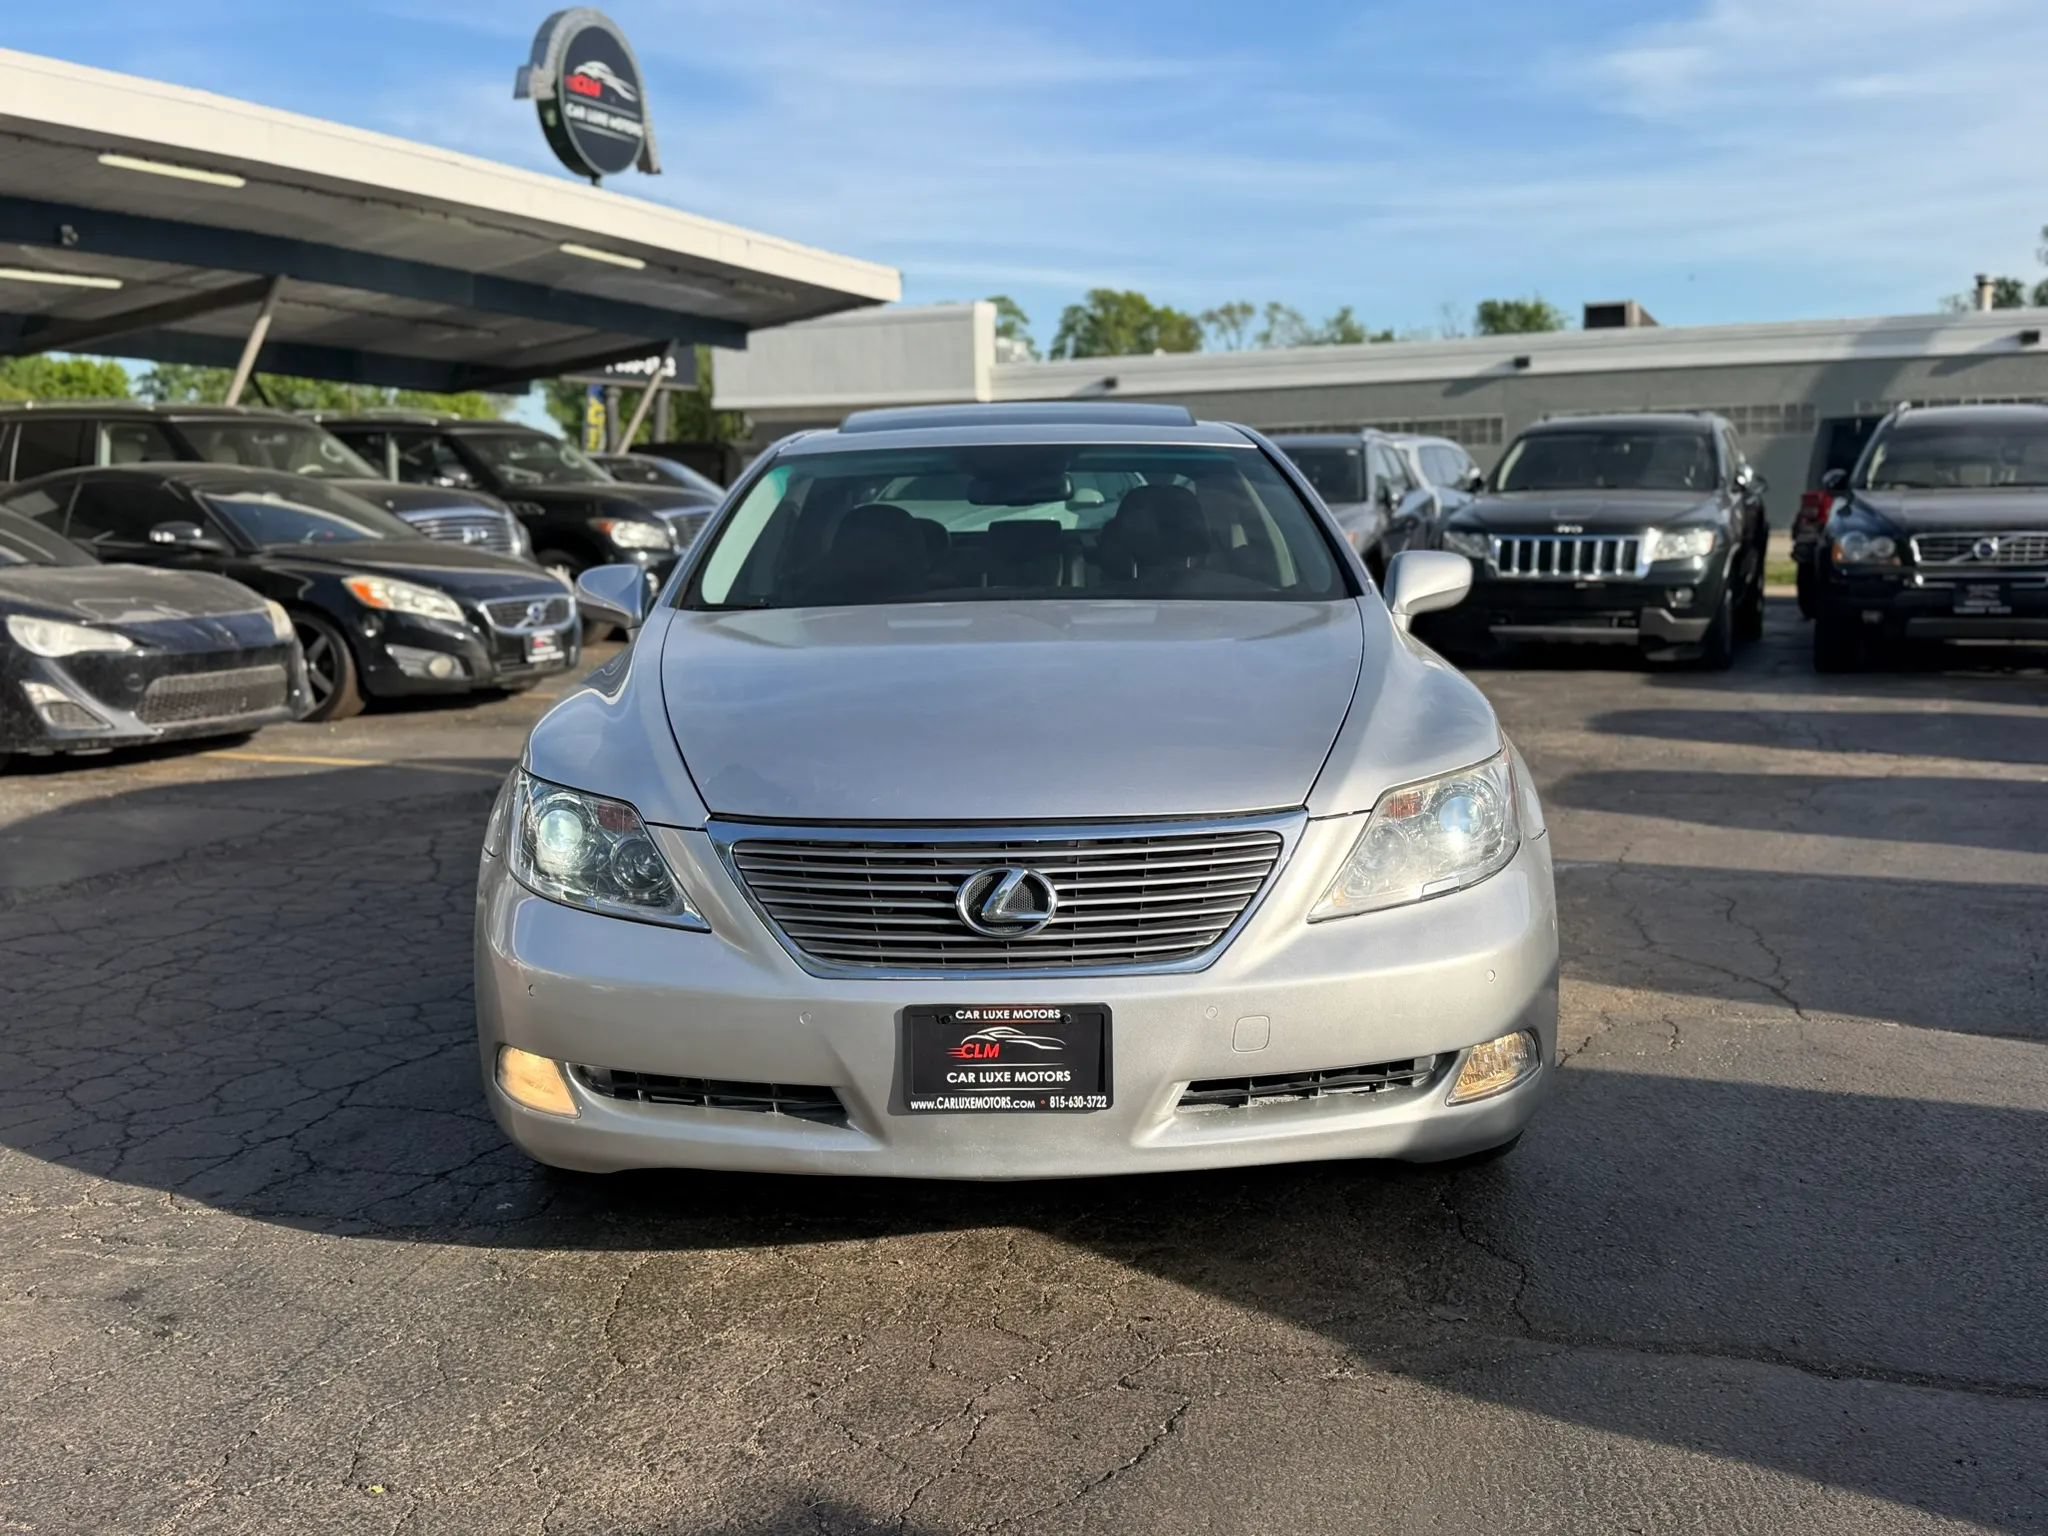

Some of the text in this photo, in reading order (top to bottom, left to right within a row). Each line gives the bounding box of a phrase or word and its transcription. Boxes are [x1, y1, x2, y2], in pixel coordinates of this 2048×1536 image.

[955, 1008, 1061, 1020] CAR LUXE MOTORS
[960, 1043, 1000, 1059] CLM
[946, 1070, 1071, 1084] CAR LUXE MOTORS
[1049, 1095, 1107, 1109] 815-630-3722
